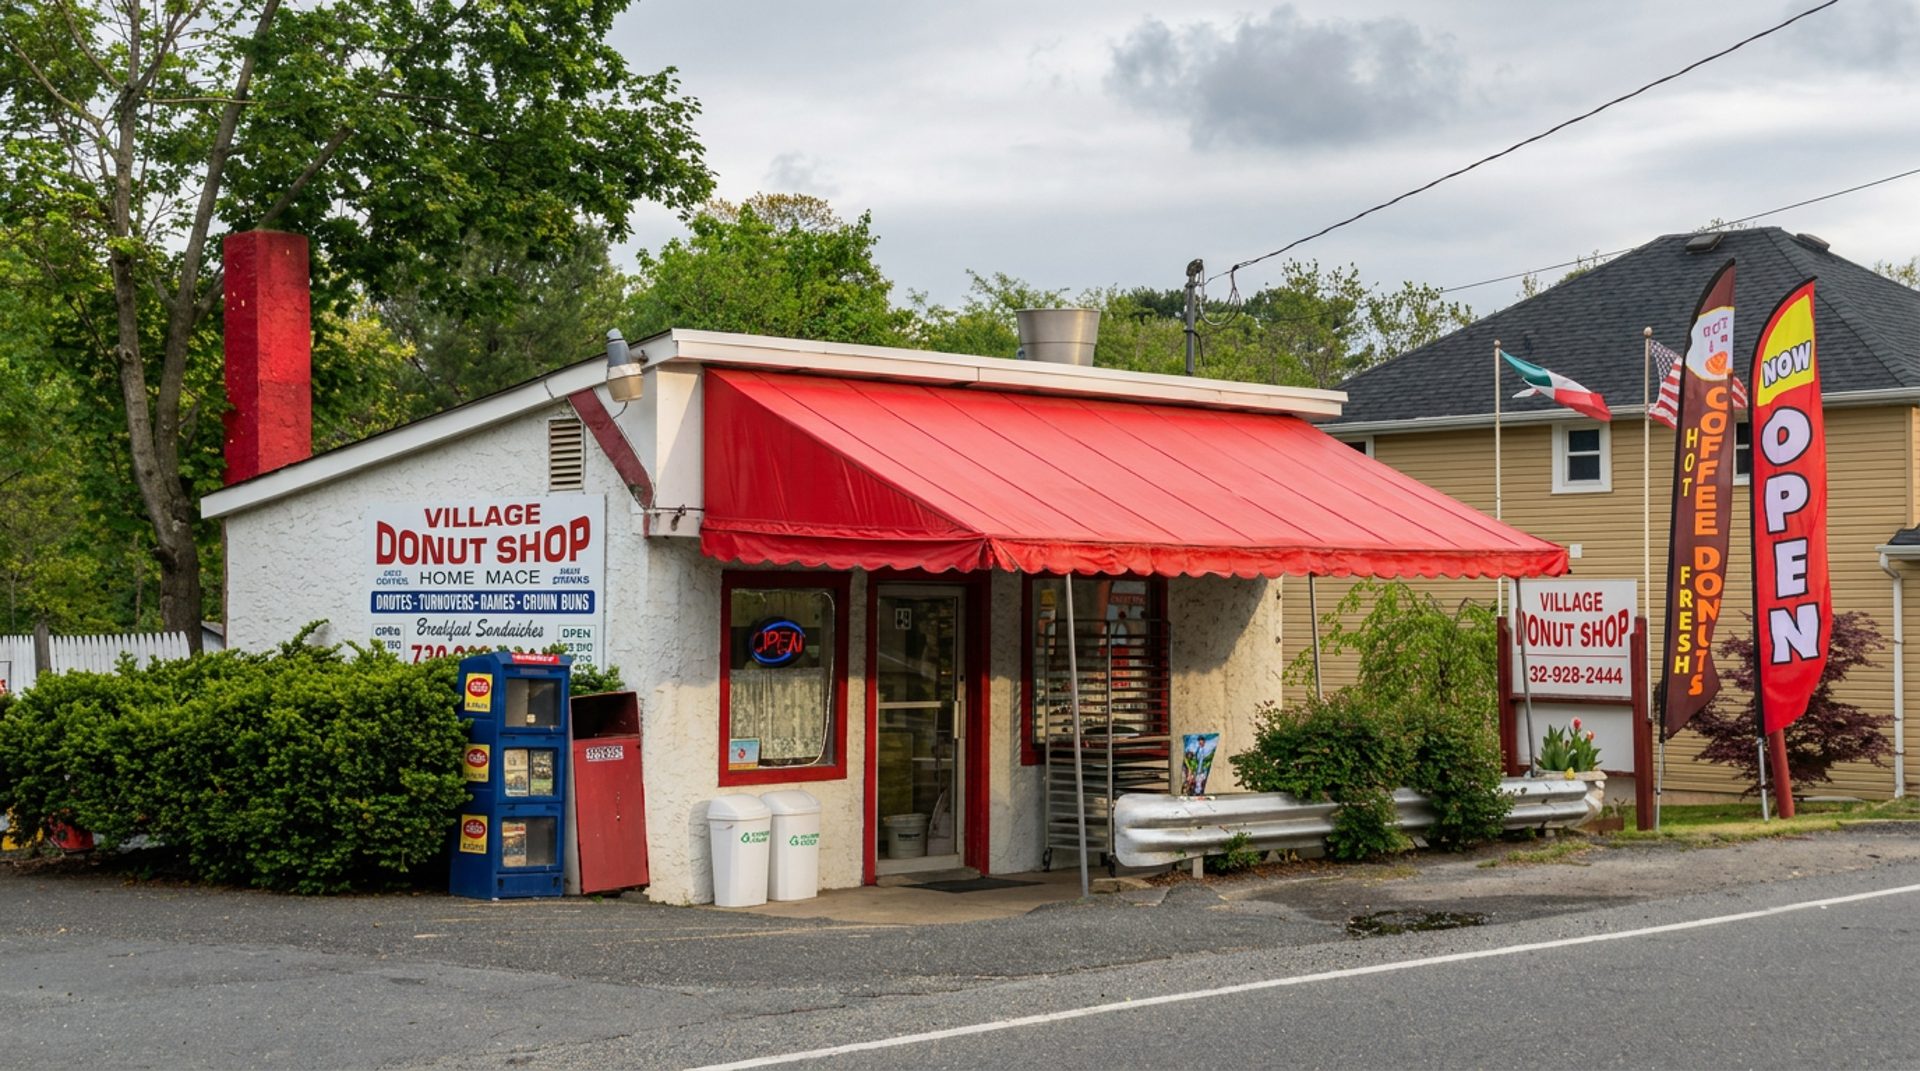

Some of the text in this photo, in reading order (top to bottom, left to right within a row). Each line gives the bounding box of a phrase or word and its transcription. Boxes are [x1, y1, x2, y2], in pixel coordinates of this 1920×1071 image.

[1762, 340, 1812, 388] NOW
[1682, 427, 1699, 497] HOT
[1695, 386, 1728, 536] COFFEE
[424, 503, 541, 528] VILLAGE
[1761, 406, 1821, 665] OPEN
[376, 515, 591, 565] DONUT SHOP
[419, 570, 475, 585] HOME
[486, 569, 541, 585] MACE
[560, 593, 590, 611] BUNS
[1540, 591, 1604, 612] VILLAGE
[1674, 566, 1694, 674] FRESH
[1580, 608, 1629, 648] SHOP
